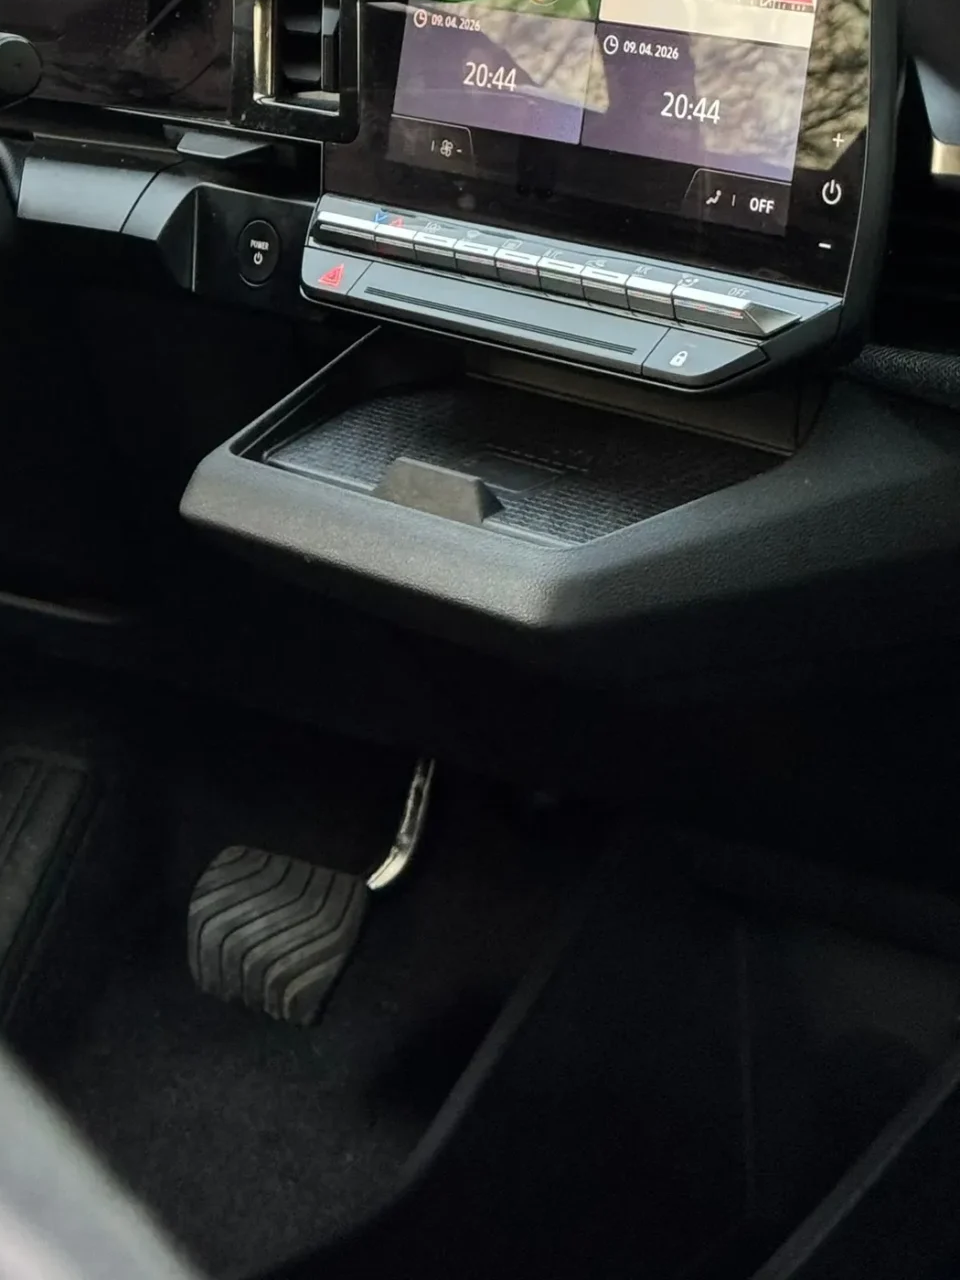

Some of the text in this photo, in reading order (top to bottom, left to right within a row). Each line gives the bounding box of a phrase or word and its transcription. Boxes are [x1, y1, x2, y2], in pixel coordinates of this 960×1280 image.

[463, 61, 517, 92] 20:44
[660, 91, 720, 125] 20:44
[749, 196, 776, 215] OFF
[250, 239, 269, 251] POWER
